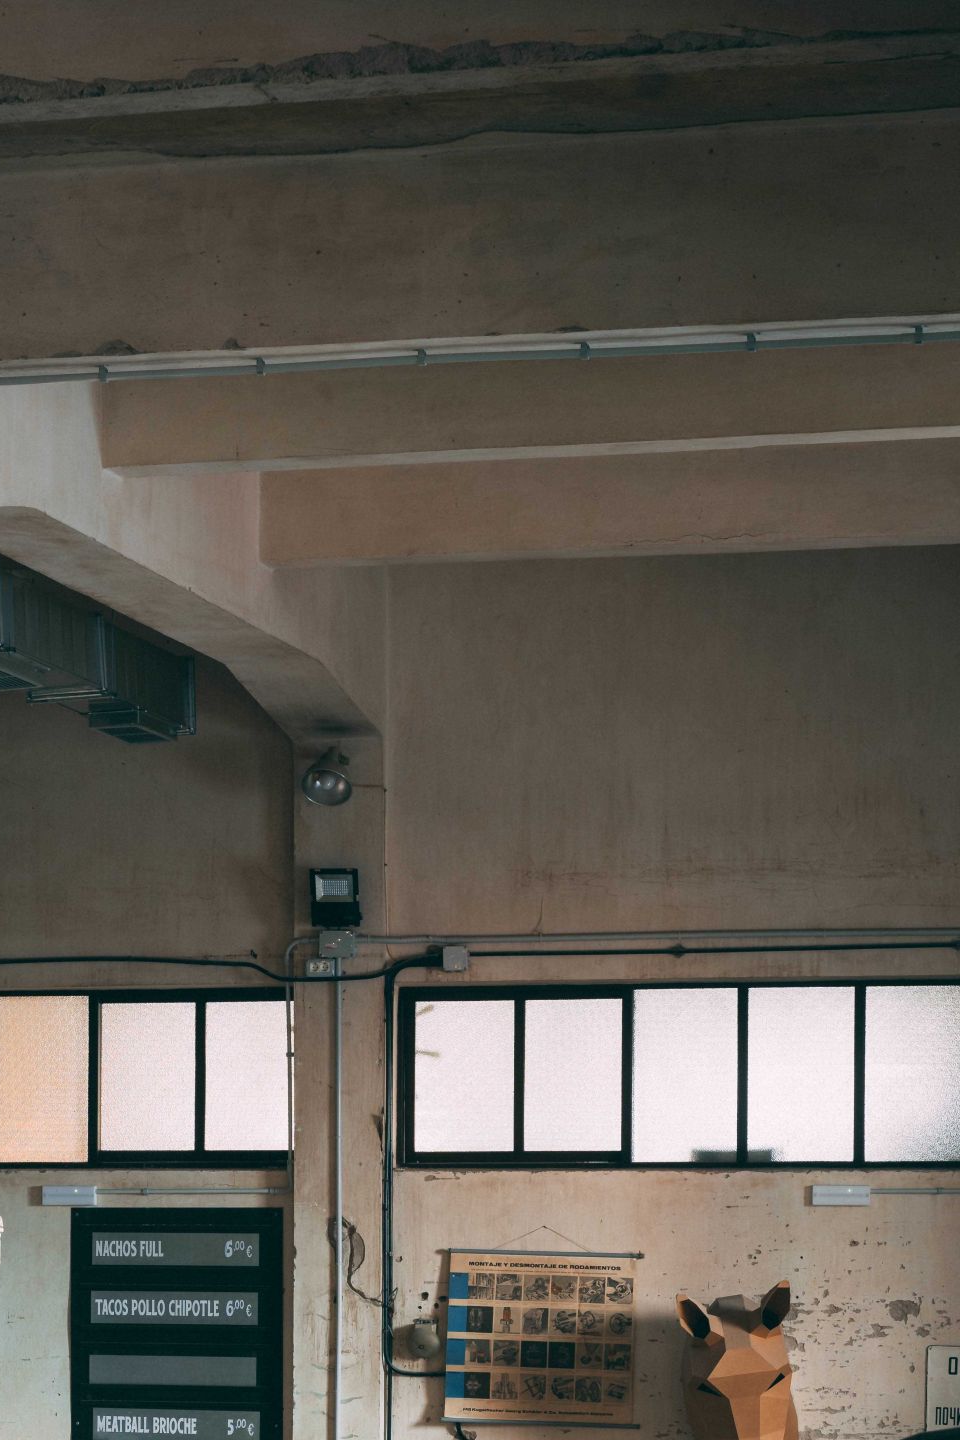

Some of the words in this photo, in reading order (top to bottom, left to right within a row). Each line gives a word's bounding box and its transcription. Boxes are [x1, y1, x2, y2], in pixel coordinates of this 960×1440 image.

[95, 1240, 137, 1258] NACHOS
[140, 1240, 164, 1258] FULL
[95, 1298, 128, 1316] TACOS
[131, 1299, 166, 1316] POLLO
[168, 1299, 220, 1317] CHIPOTLE
[96, 1415, 150, 1434] MEATBALL
[152, 1416, 198, 1435] BRIOCHE
